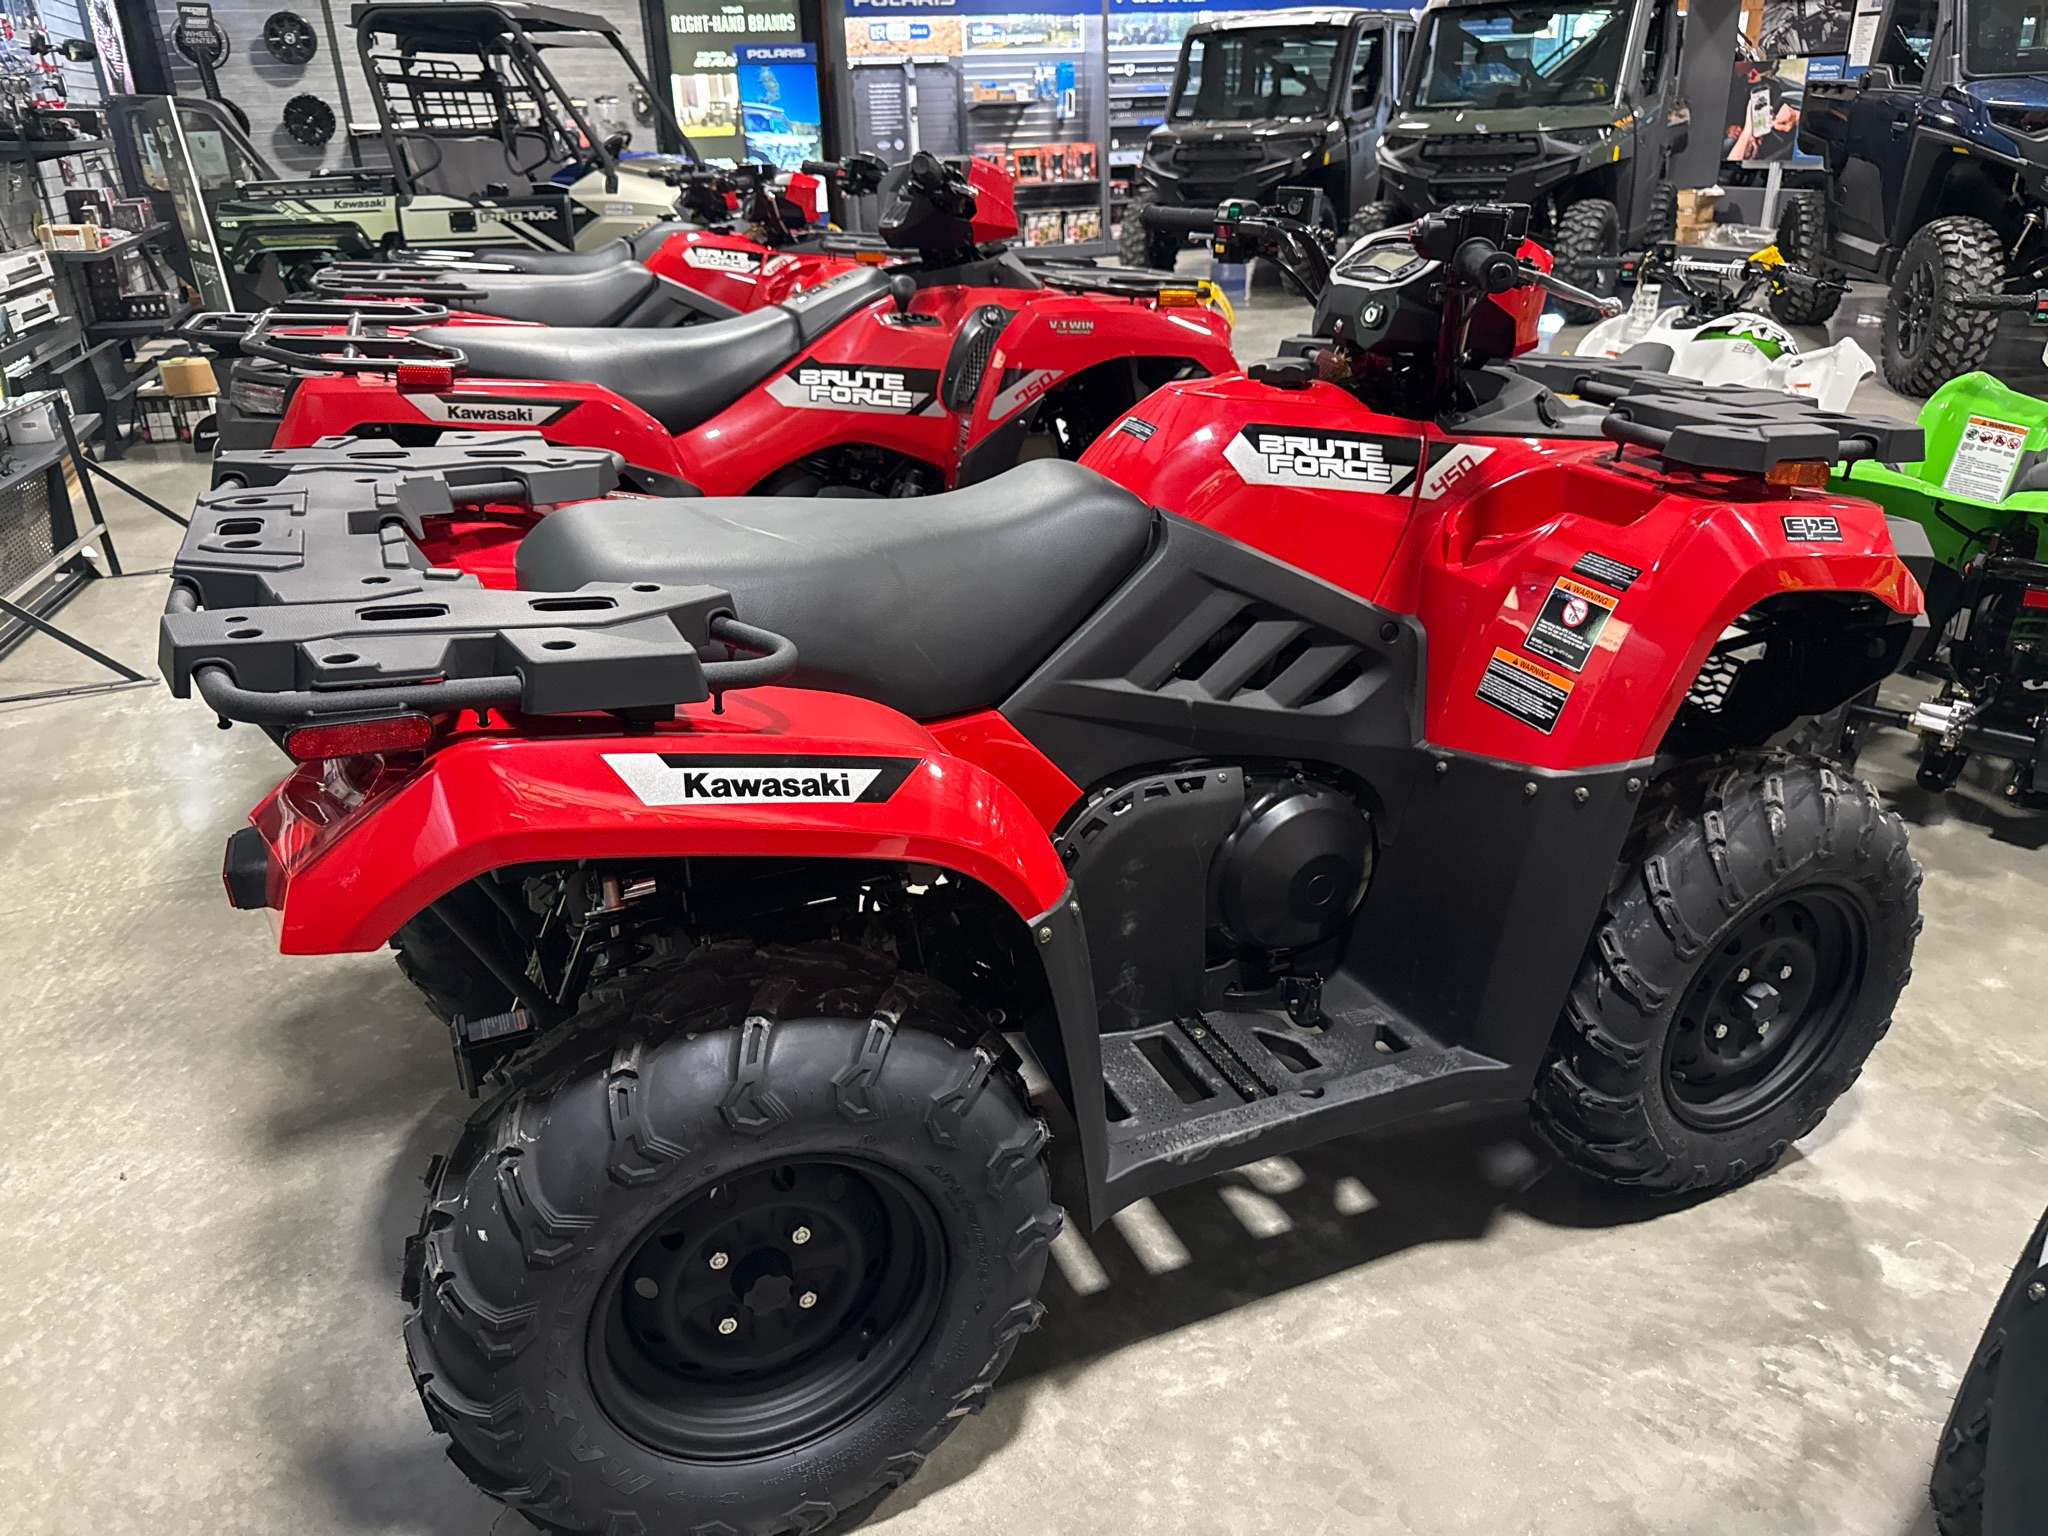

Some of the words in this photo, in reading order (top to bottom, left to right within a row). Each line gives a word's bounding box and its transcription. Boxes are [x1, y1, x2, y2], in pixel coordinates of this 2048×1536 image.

[670, 14, 746, 33] RIGHT-HAND
[747, 13, 796, 32] BRANDS
[746, 48, 807, 59] POLARIS
[334, 198, 387, 210] Kawasaki
[480, 210, 558, 223] PRO-MX
[799, 368, 905, 390] BRUTE
[1014, 373, 1053, 401] 750
[810, 386, 914, 408] FORCE
[447, 405, 533, 422] Kawasaki
[1258, 434, 1384, 463] BRUTE
[1268, 455, 1393, 483] FORCE
[1429, 454, 1476, 493] 450
[1785, 518, 1838, 536] EPS
[1572, 584, 1609, 606] WARNING
[1519, 660, 1551, 681] WARNING
[683, 773, 851, 798] Kawasaki
